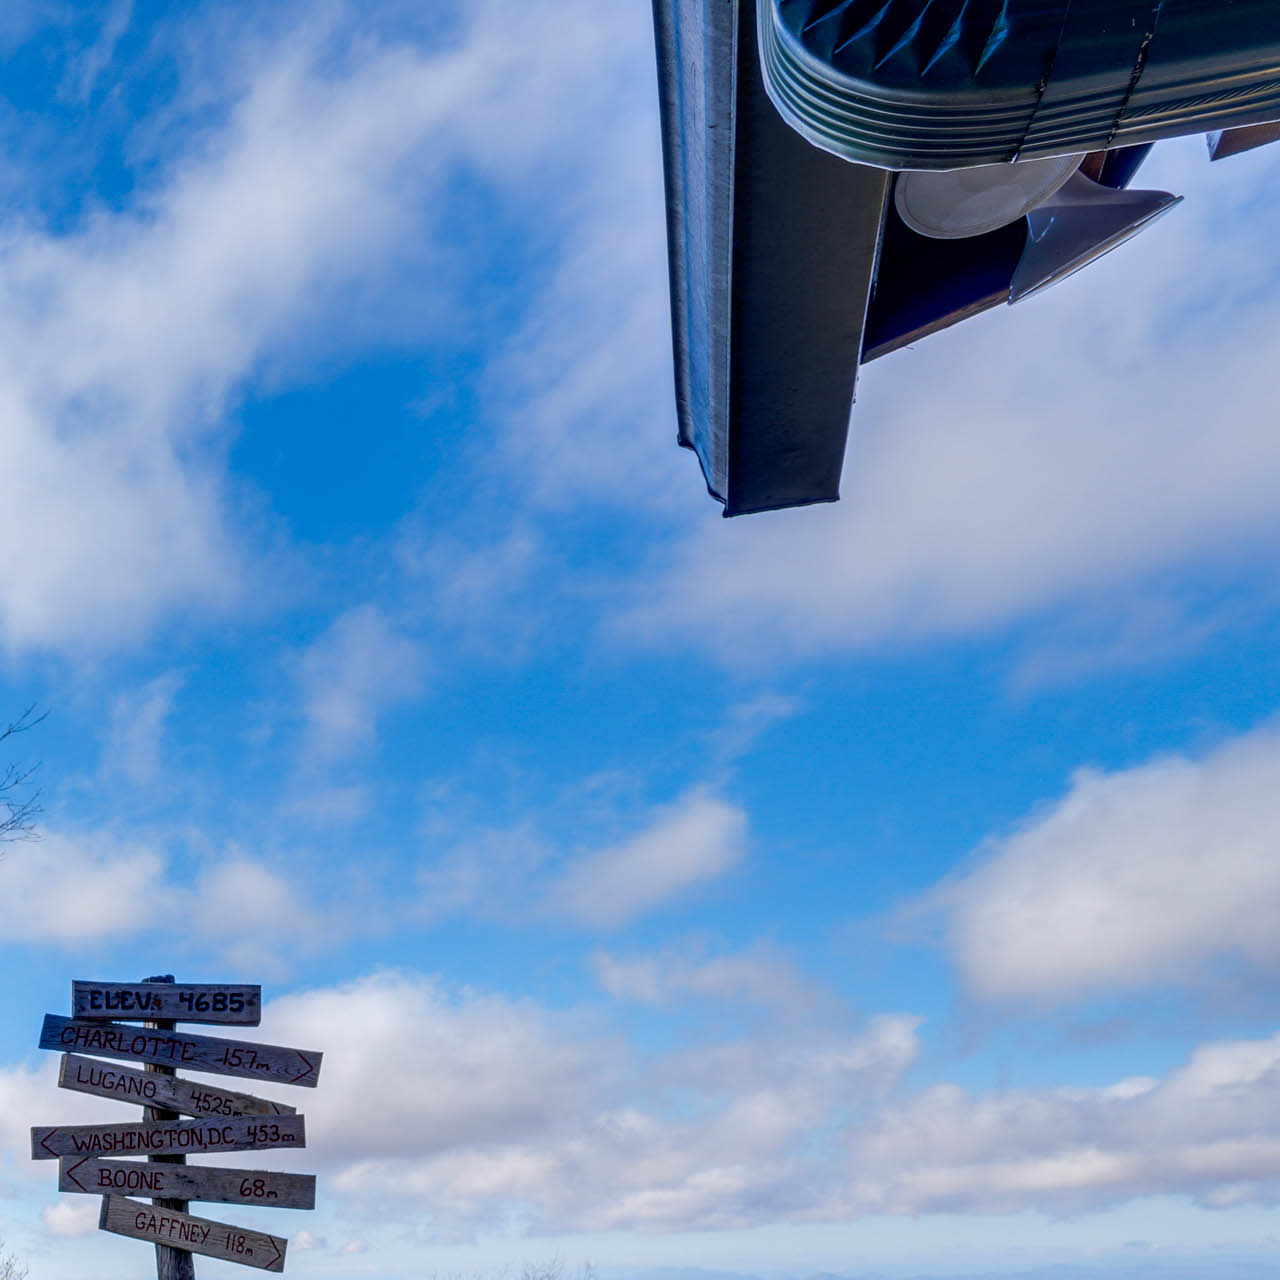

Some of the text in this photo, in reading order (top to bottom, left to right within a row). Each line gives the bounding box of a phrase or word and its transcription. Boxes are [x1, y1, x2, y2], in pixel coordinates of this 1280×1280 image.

[179, 991, 245, 1012] 4685
[60, 1026, 270, 1072] CHARLOTTE 157m
[76, 1064, 157, 1098] LUGANO
[247, 1124, 296, 1144] 453m
[97, 1168, 278, 1198] BOONE 68m
[135, 1212, 253, 1257] GAFFNEY 118m
